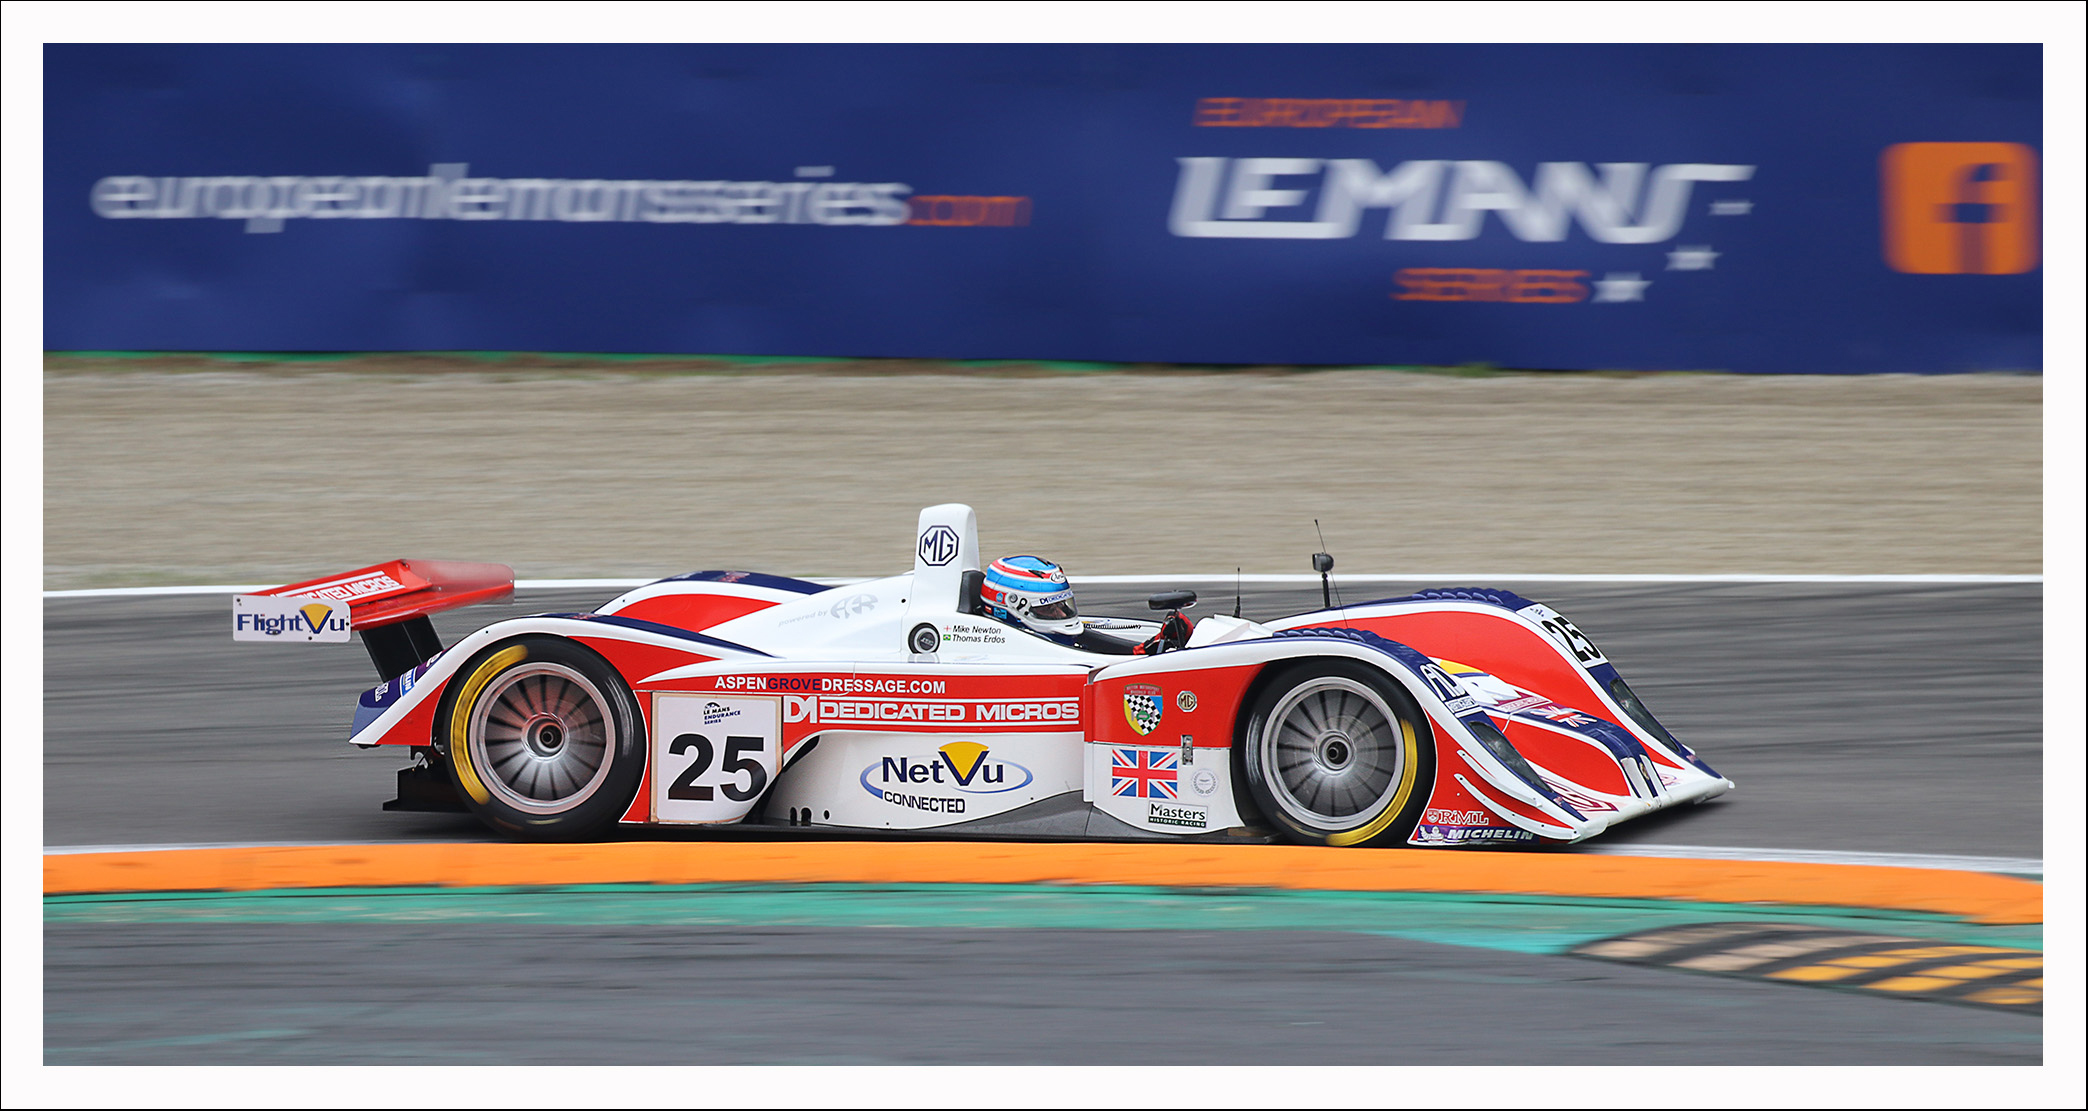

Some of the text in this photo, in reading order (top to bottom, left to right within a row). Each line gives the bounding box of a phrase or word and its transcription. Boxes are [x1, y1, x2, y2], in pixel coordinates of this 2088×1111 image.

[922, 528, 957, 563] MG
[345, 575, 400, 595] MICROS
[952, 624, 1002, 635] Mike Newton
[952, 634, 1006, 644] Thomas Erdos
[1541, 616, 1601, 662] 25
[712, 706, 731, 714] MANS
[1180, 695, 1194, 707] MG
[704, 710, 741, 720] ENDURANCE
[819, 702, 965, 721] DEDICATED
[975, 702, 1079, 721] MICROS
[667, 734, 767, 802] 25
[882, 741, 1004, 787] NetVu
[883, 790, 965, 814] CONNECTED
[1150, 803, 1205, 820] Masters
[1447, 829, 1534, 841] MICHELIN
